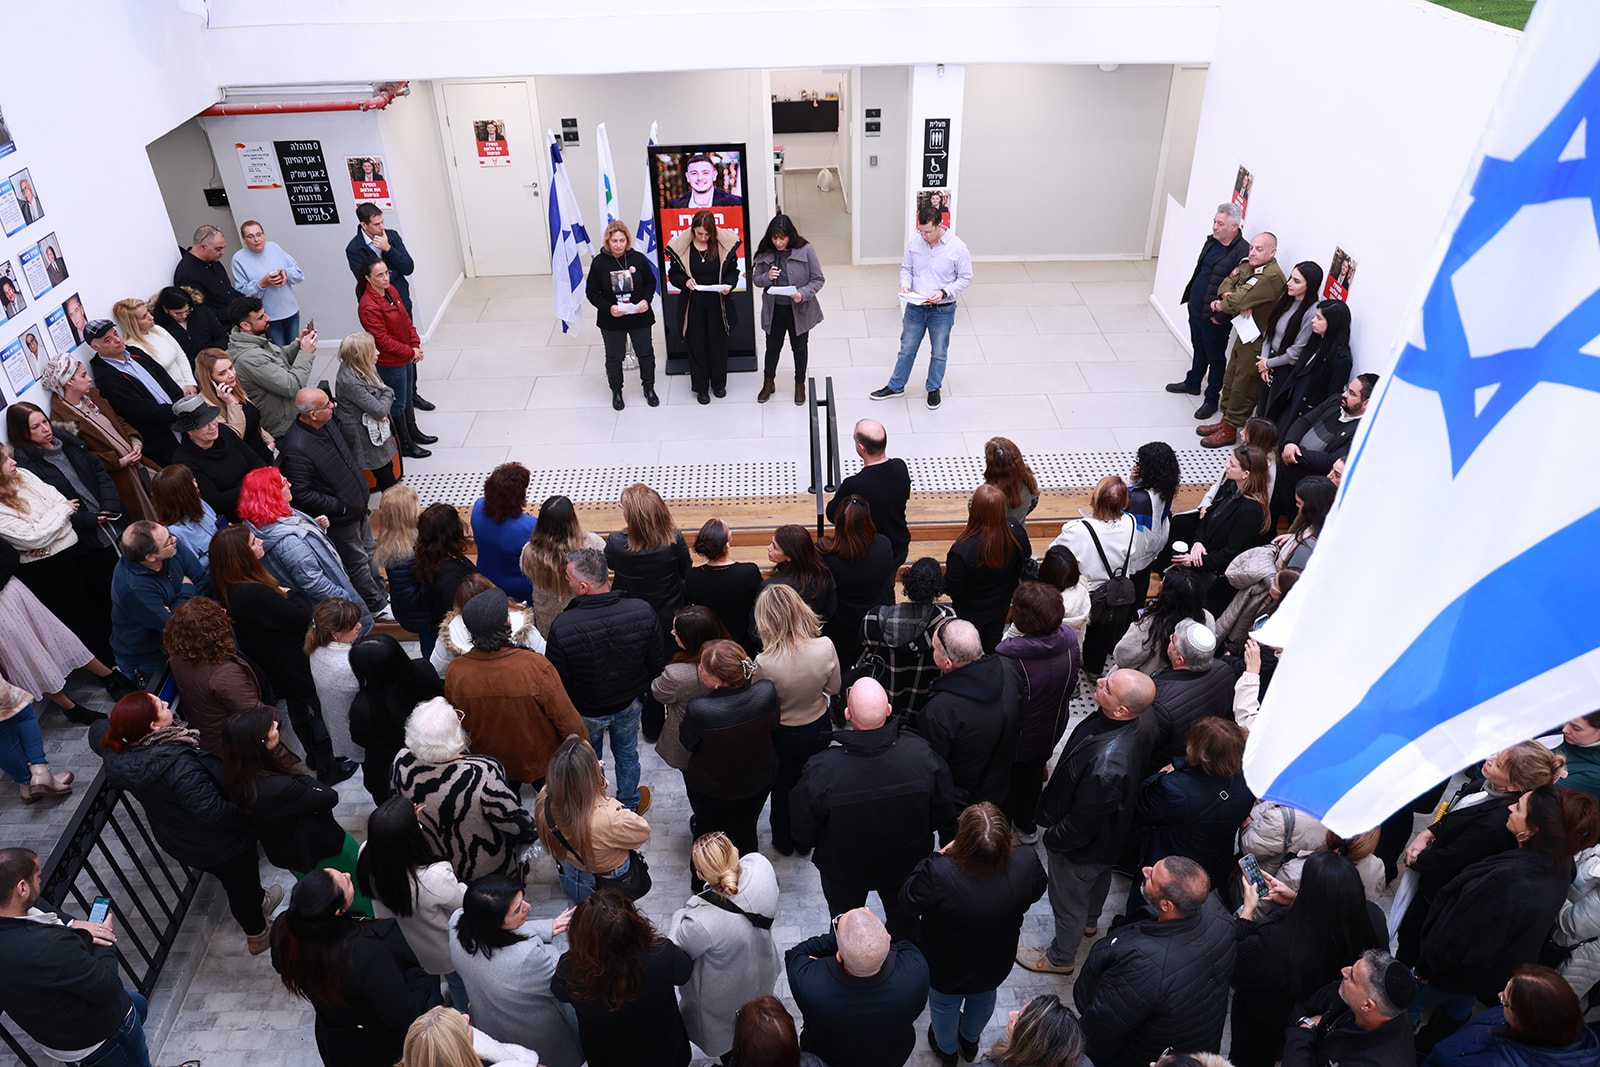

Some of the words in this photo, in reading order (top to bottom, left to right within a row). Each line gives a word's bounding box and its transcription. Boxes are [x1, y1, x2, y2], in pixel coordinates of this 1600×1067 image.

[290, 142, 313, 151] מנהלה
[283, 156, 304, 166] החינוך
[303, 156, 316, 165] אגף
[317, 155, 322, 163] 1
[307, 170, 320, 179] אגף
[320, 169, 326, 177] 2
[293, 185, 314, 193] מעלית
[298, 194, 322, 202] מדרגות
[297, 207, 319, 215] שירותי
[307, 214, 321, 222] נכים
